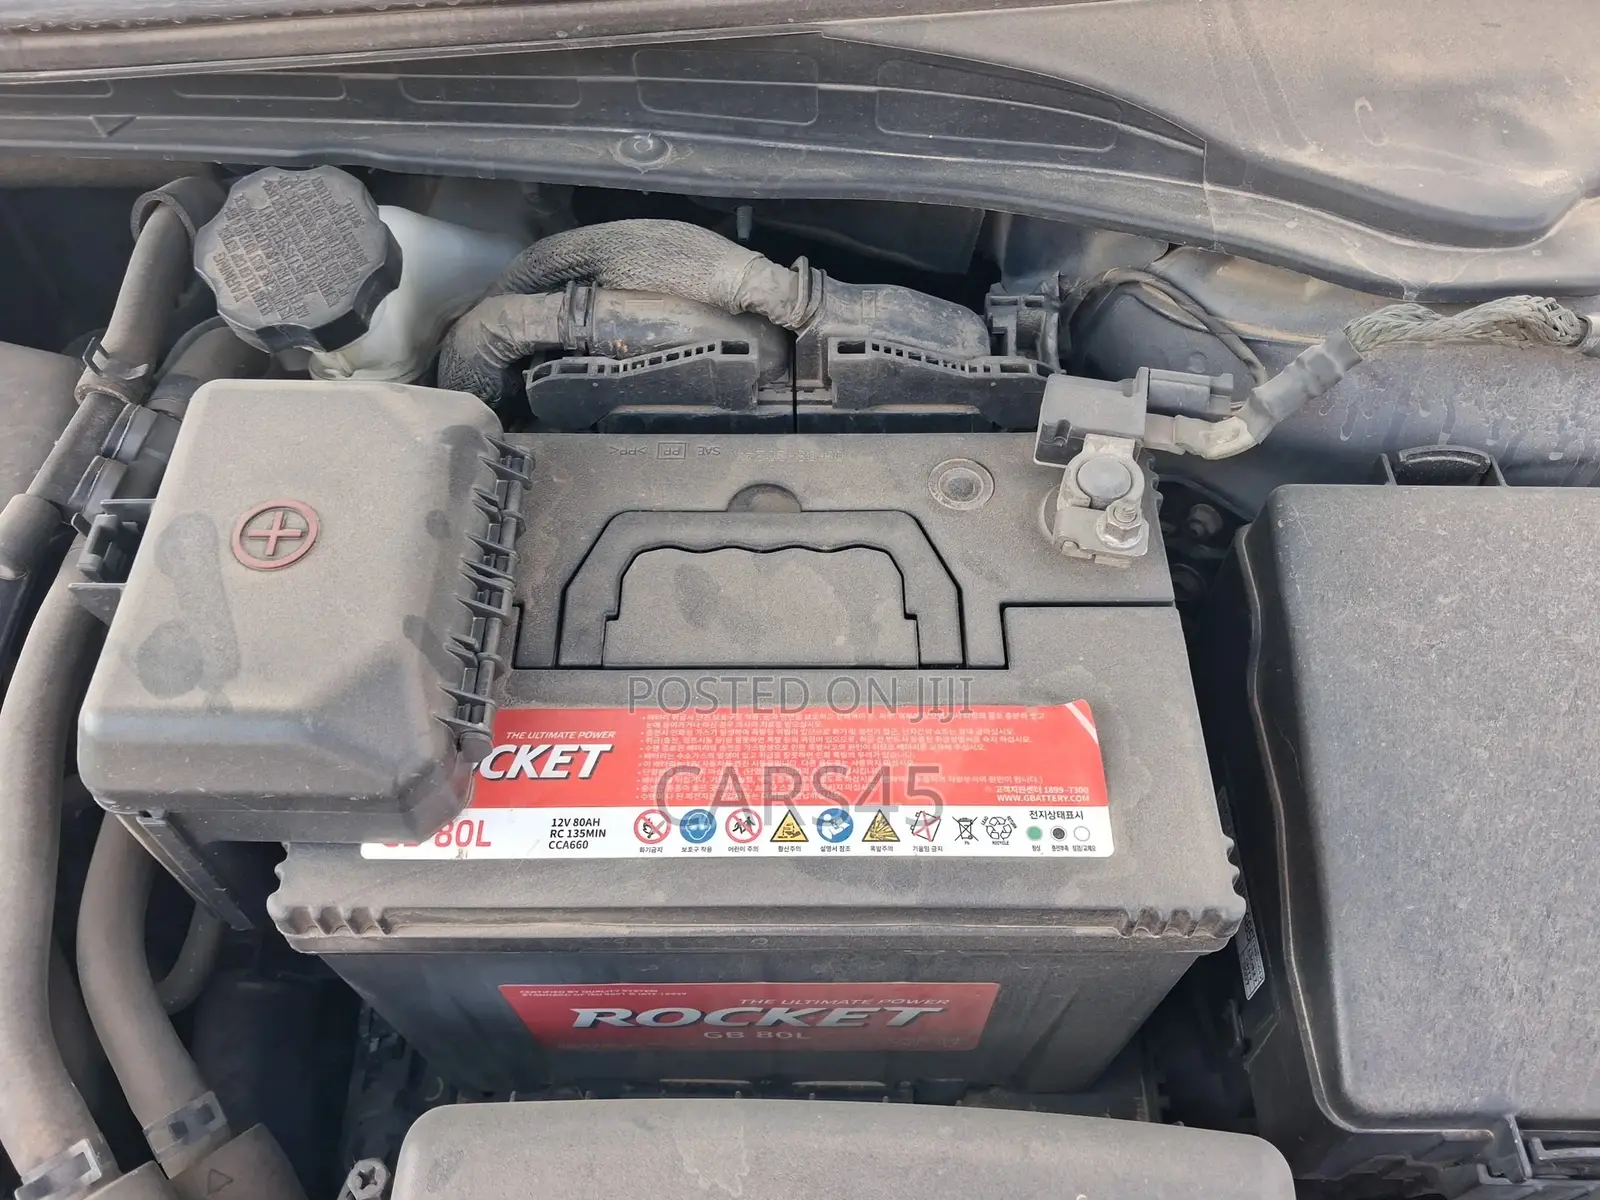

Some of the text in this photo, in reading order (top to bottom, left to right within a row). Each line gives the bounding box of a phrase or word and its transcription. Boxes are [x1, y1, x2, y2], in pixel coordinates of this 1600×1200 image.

[698, 446, 720, 456] SAE
[476, 744, 613, 780] CKET
[1029, 810, 1084, 820] 전지상태표시
[552, 818, 600, 827] 12V 80AH
[550, 829, 606, 838] RC 135MIN
[548, 840, 588, 850] CCA660
[570, 1007, 944, 1027] ROCKET
[756, 1031, 811, 1040] 80L
